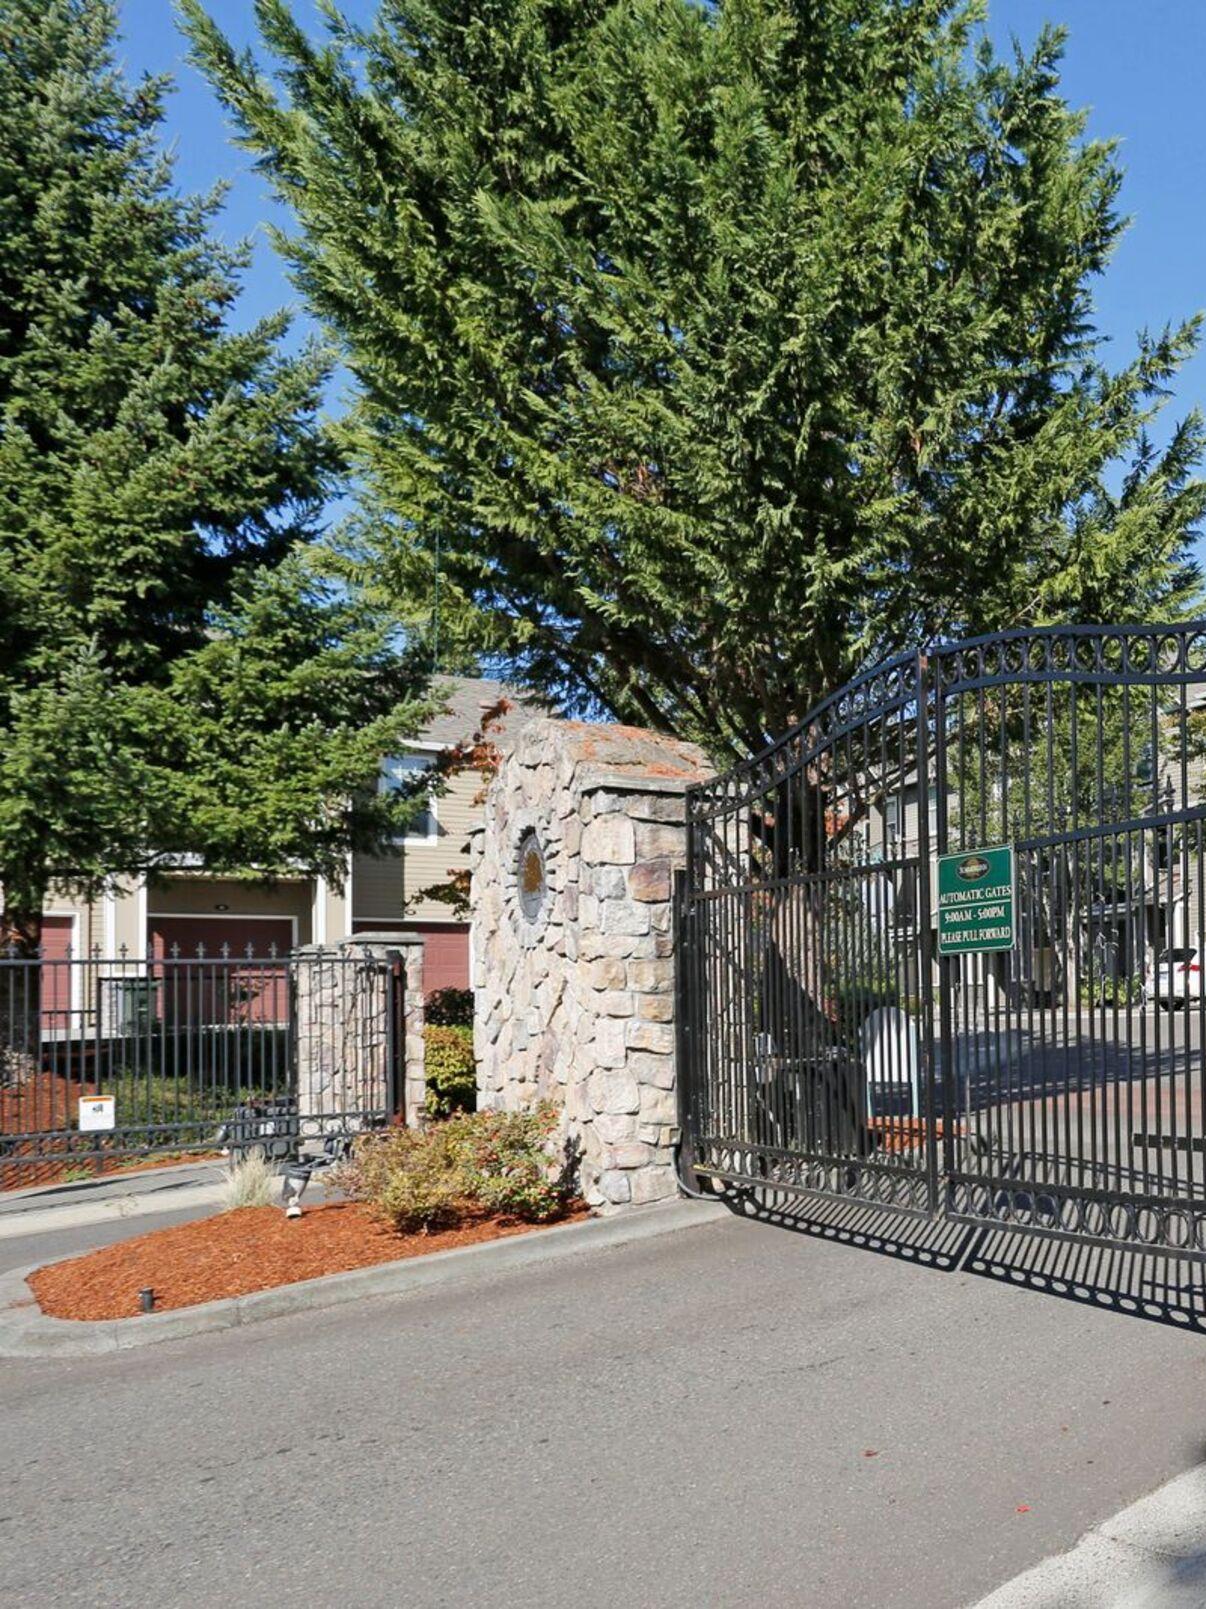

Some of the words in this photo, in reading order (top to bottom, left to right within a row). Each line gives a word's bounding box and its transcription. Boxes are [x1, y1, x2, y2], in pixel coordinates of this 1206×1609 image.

[940, 888, 984, 904] AUTOMATIC
[985, 885, 1011, 898] GATES
[941, 931, 962, 943] PLEASE
[962, 929, 978, 942] PULL
[979, 926, 1011, 941] FORWARD
